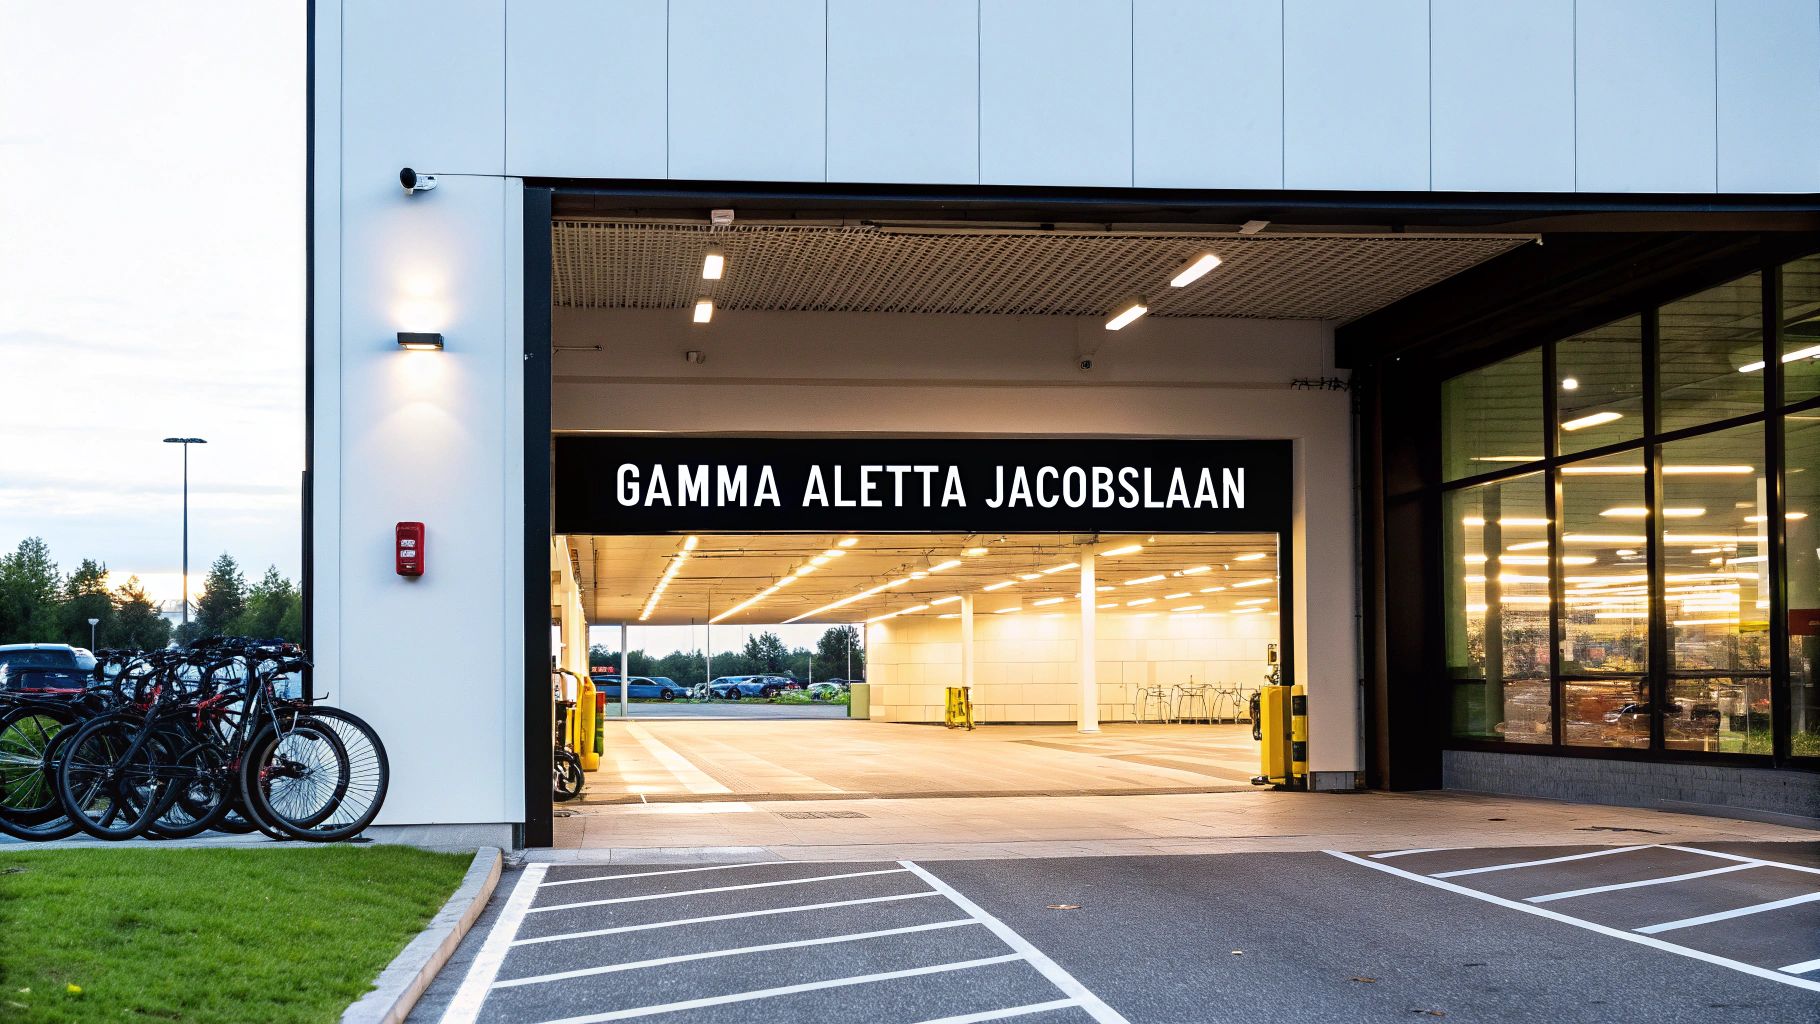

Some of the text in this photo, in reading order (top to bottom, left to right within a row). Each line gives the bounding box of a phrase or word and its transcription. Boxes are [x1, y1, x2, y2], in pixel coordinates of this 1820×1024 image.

[616, 463, 1245, 509] GAMMA ALETTA JACOBSLAAN
